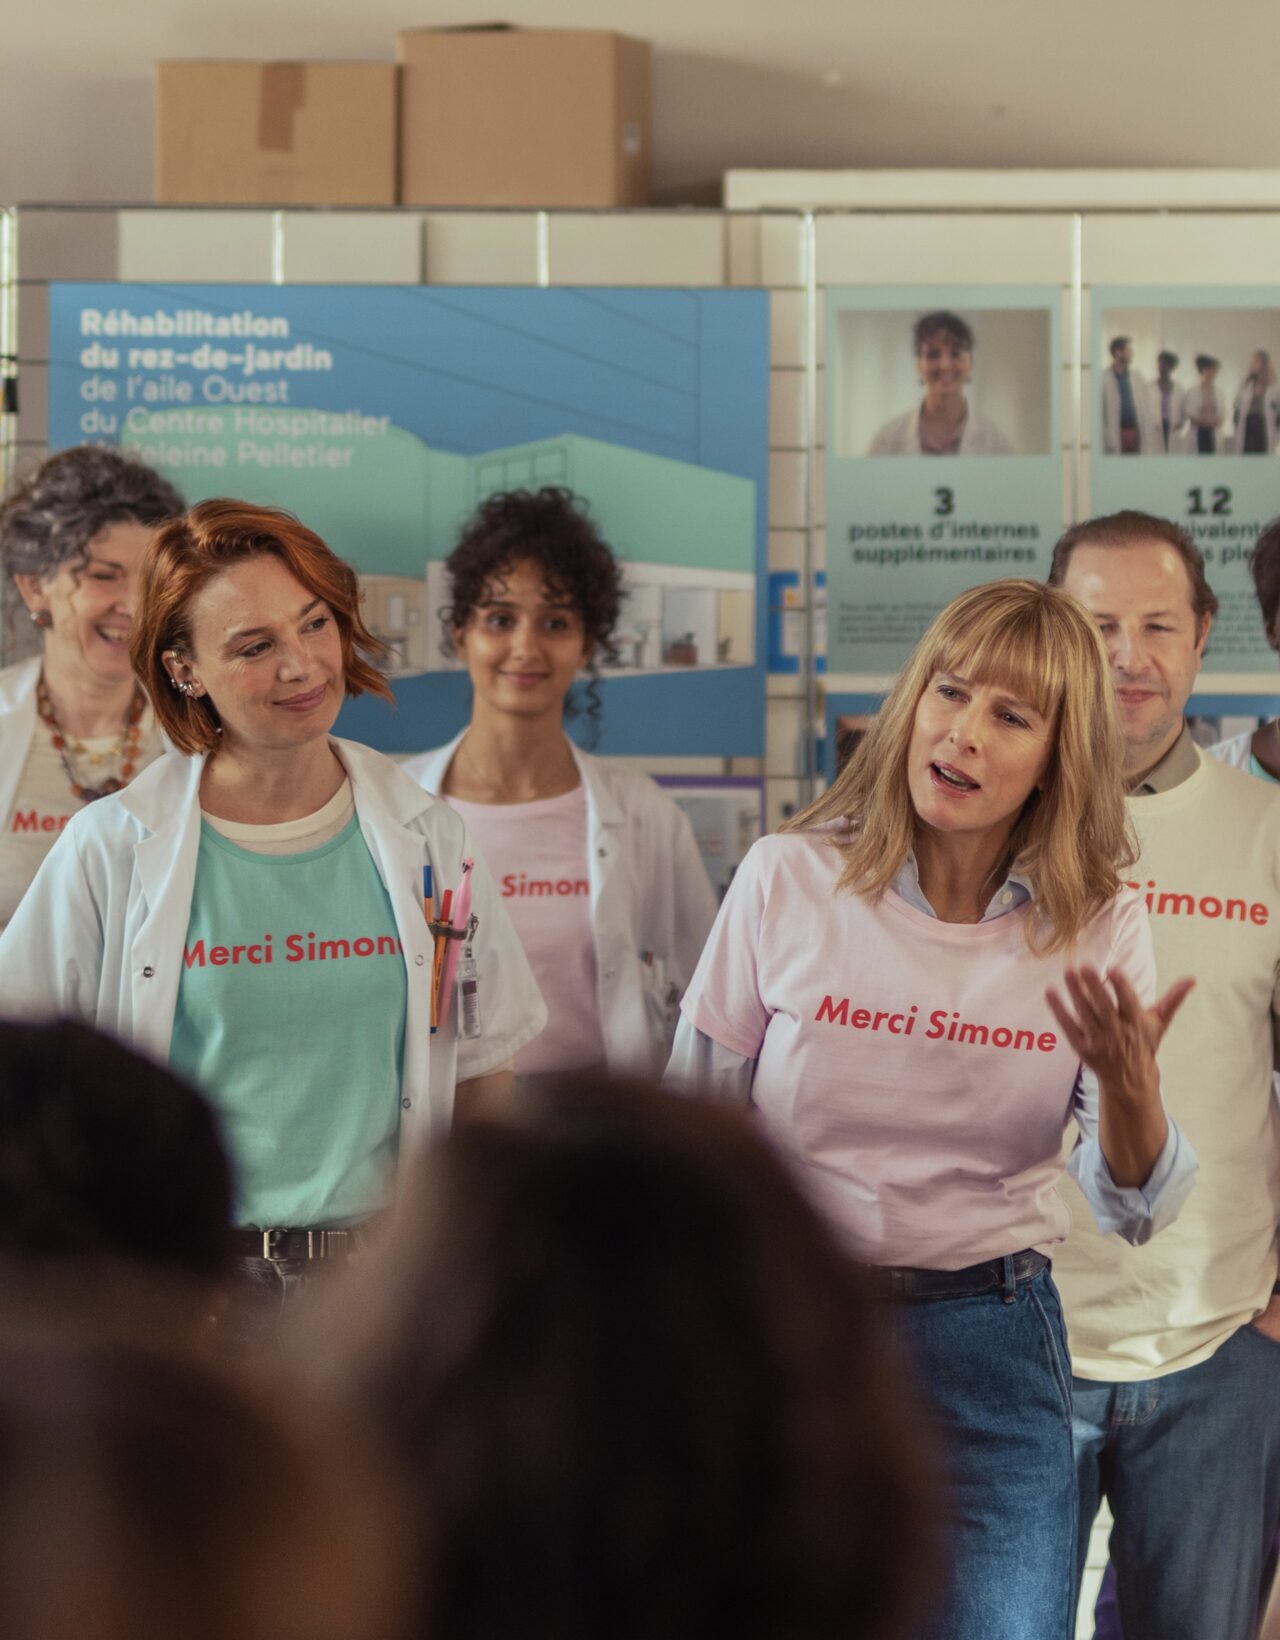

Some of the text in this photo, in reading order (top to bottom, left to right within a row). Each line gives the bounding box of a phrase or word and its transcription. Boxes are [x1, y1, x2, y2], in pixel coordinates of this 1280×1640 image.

[80, 308, 290, 338] Réhabilitation
[80, 342, 333, 375] du rez-de-jardin
[80, 376, 118, 402] de
[202, 375, 290, 403] Ouest
[80, 406, 390, 440] du Centre Hospitalier
[238, 441, 354, 468] Pelletier
[933, 486, 956, 516] 3
[1186, 485, 1234, 517] 12
[848, 522, 923, 543] postes
[853, 541, 1037, 565] supplémentaires
[10, 809, 68, 834] Mer
[500, 872, 590, 898] Simon
[182, 931, 402, 969] Merci Simon
[814, 994, 1058, 1053] Merci Simone
